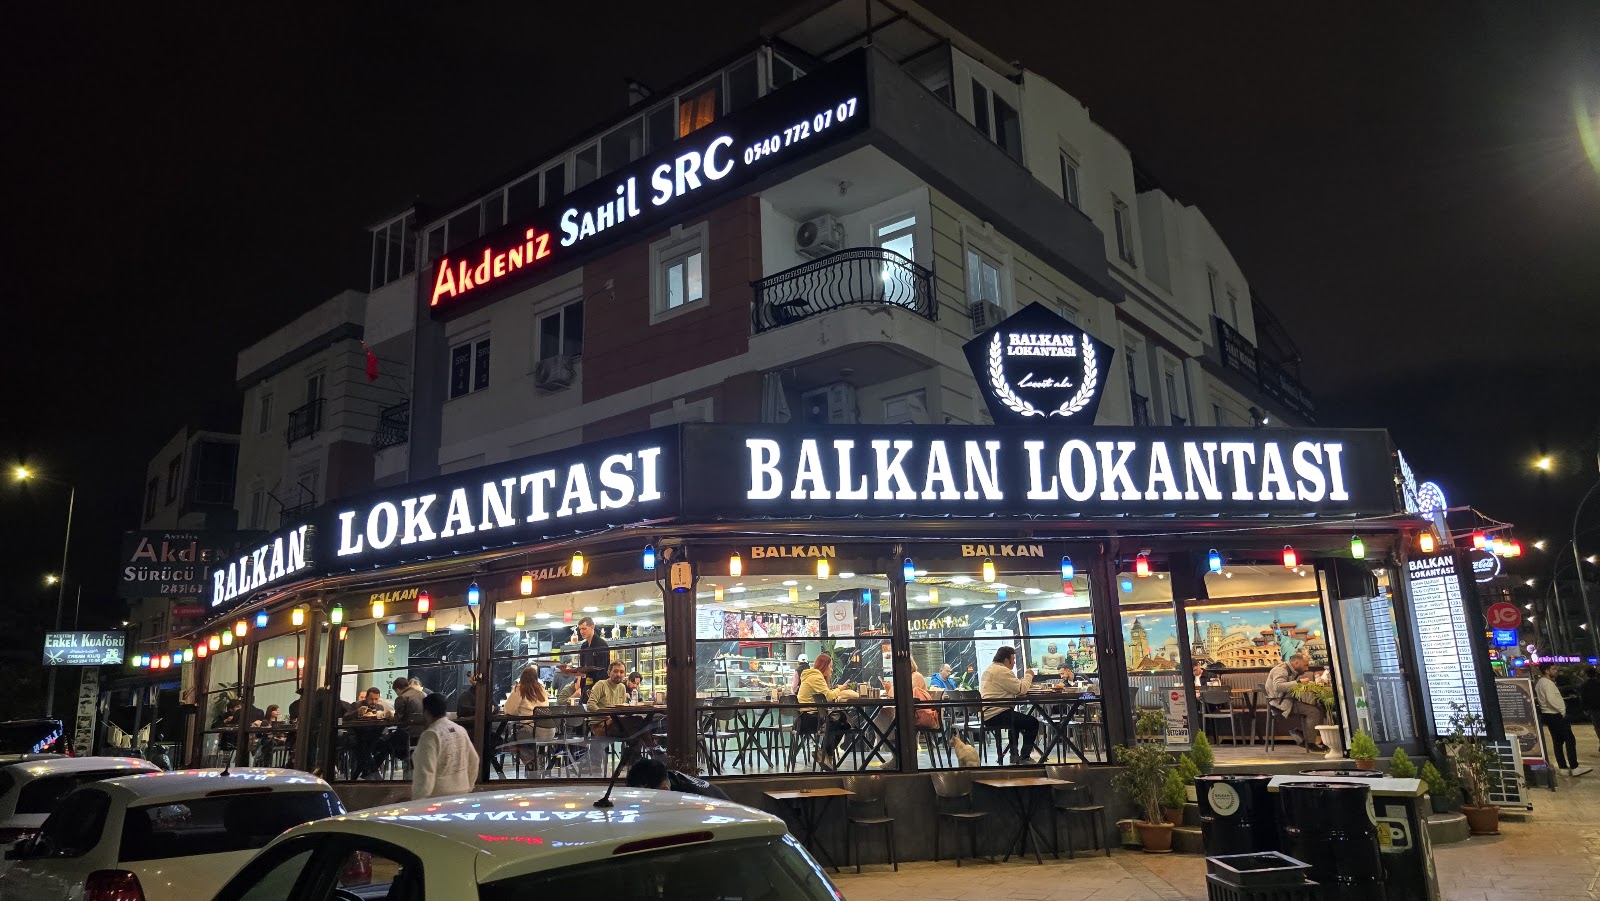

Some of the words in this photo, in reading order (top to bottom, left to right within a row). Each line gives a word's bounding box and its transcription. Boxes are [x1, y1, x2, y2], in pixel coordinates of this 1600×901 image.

[651, 136, 735, 207] SRC
[744, 135, 781, 165] 0540
[784, 120, 810, 147] 772
[813, 109, 833, 133] 07
[836, 97, 857, 122] 07
[1008, 333, 1074, 346] BALKAN
[1006, 346, 1077, 357] LOKANTASI
[745, 439, 1004, 501] BALKAN
[1024, 439, 1350, 503] LOKANTASI
[211, 524, 308, 607] BALKAN
[337, 447, 662, 557] LOKANTASI
[751, 545, 836, 559] BALKAN
[961, 544, 1044, 558] BALKAN
[1409, 556, 1454, 571] BALKAN
[1410, 567, 1455, 579] LOKANTASI
